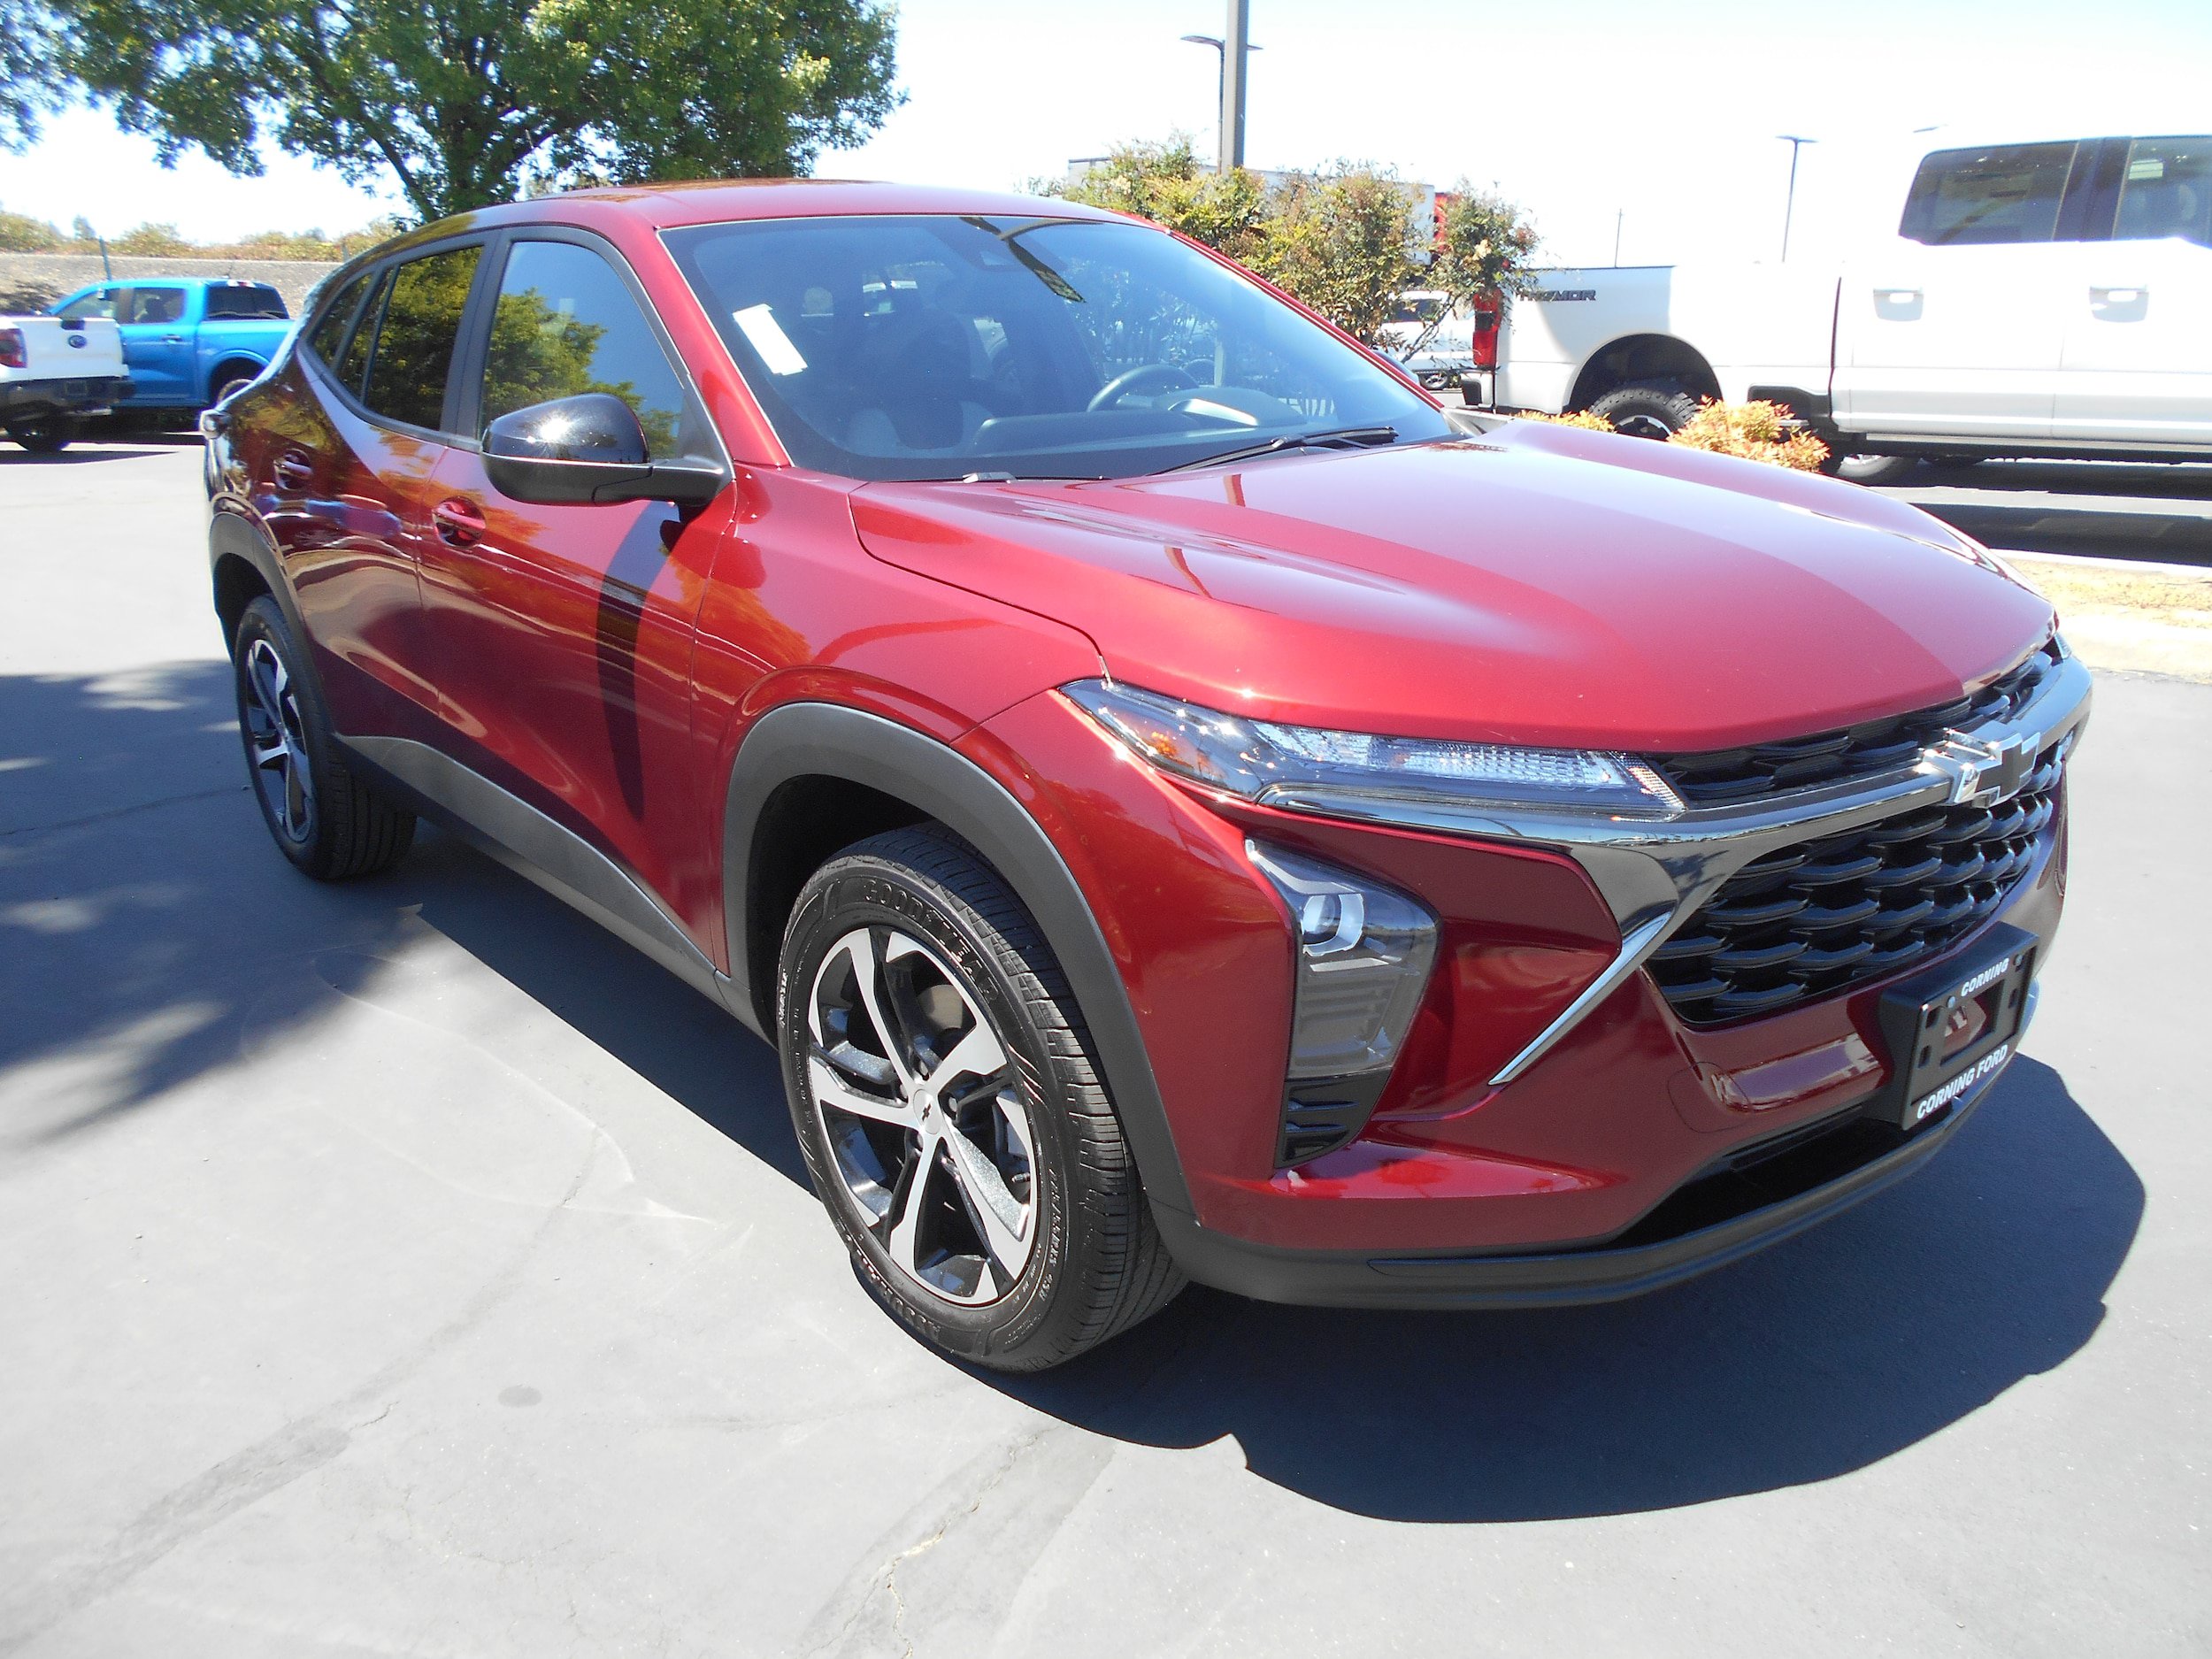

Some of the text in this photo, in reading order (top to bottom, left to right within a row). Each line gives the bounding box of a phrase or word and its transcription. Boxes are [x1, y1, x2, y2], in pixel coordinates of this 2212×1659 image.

[1961, 957, 2009, 996] CORNING
[1916, 1044, 2008, 1119] CORNING FORD
